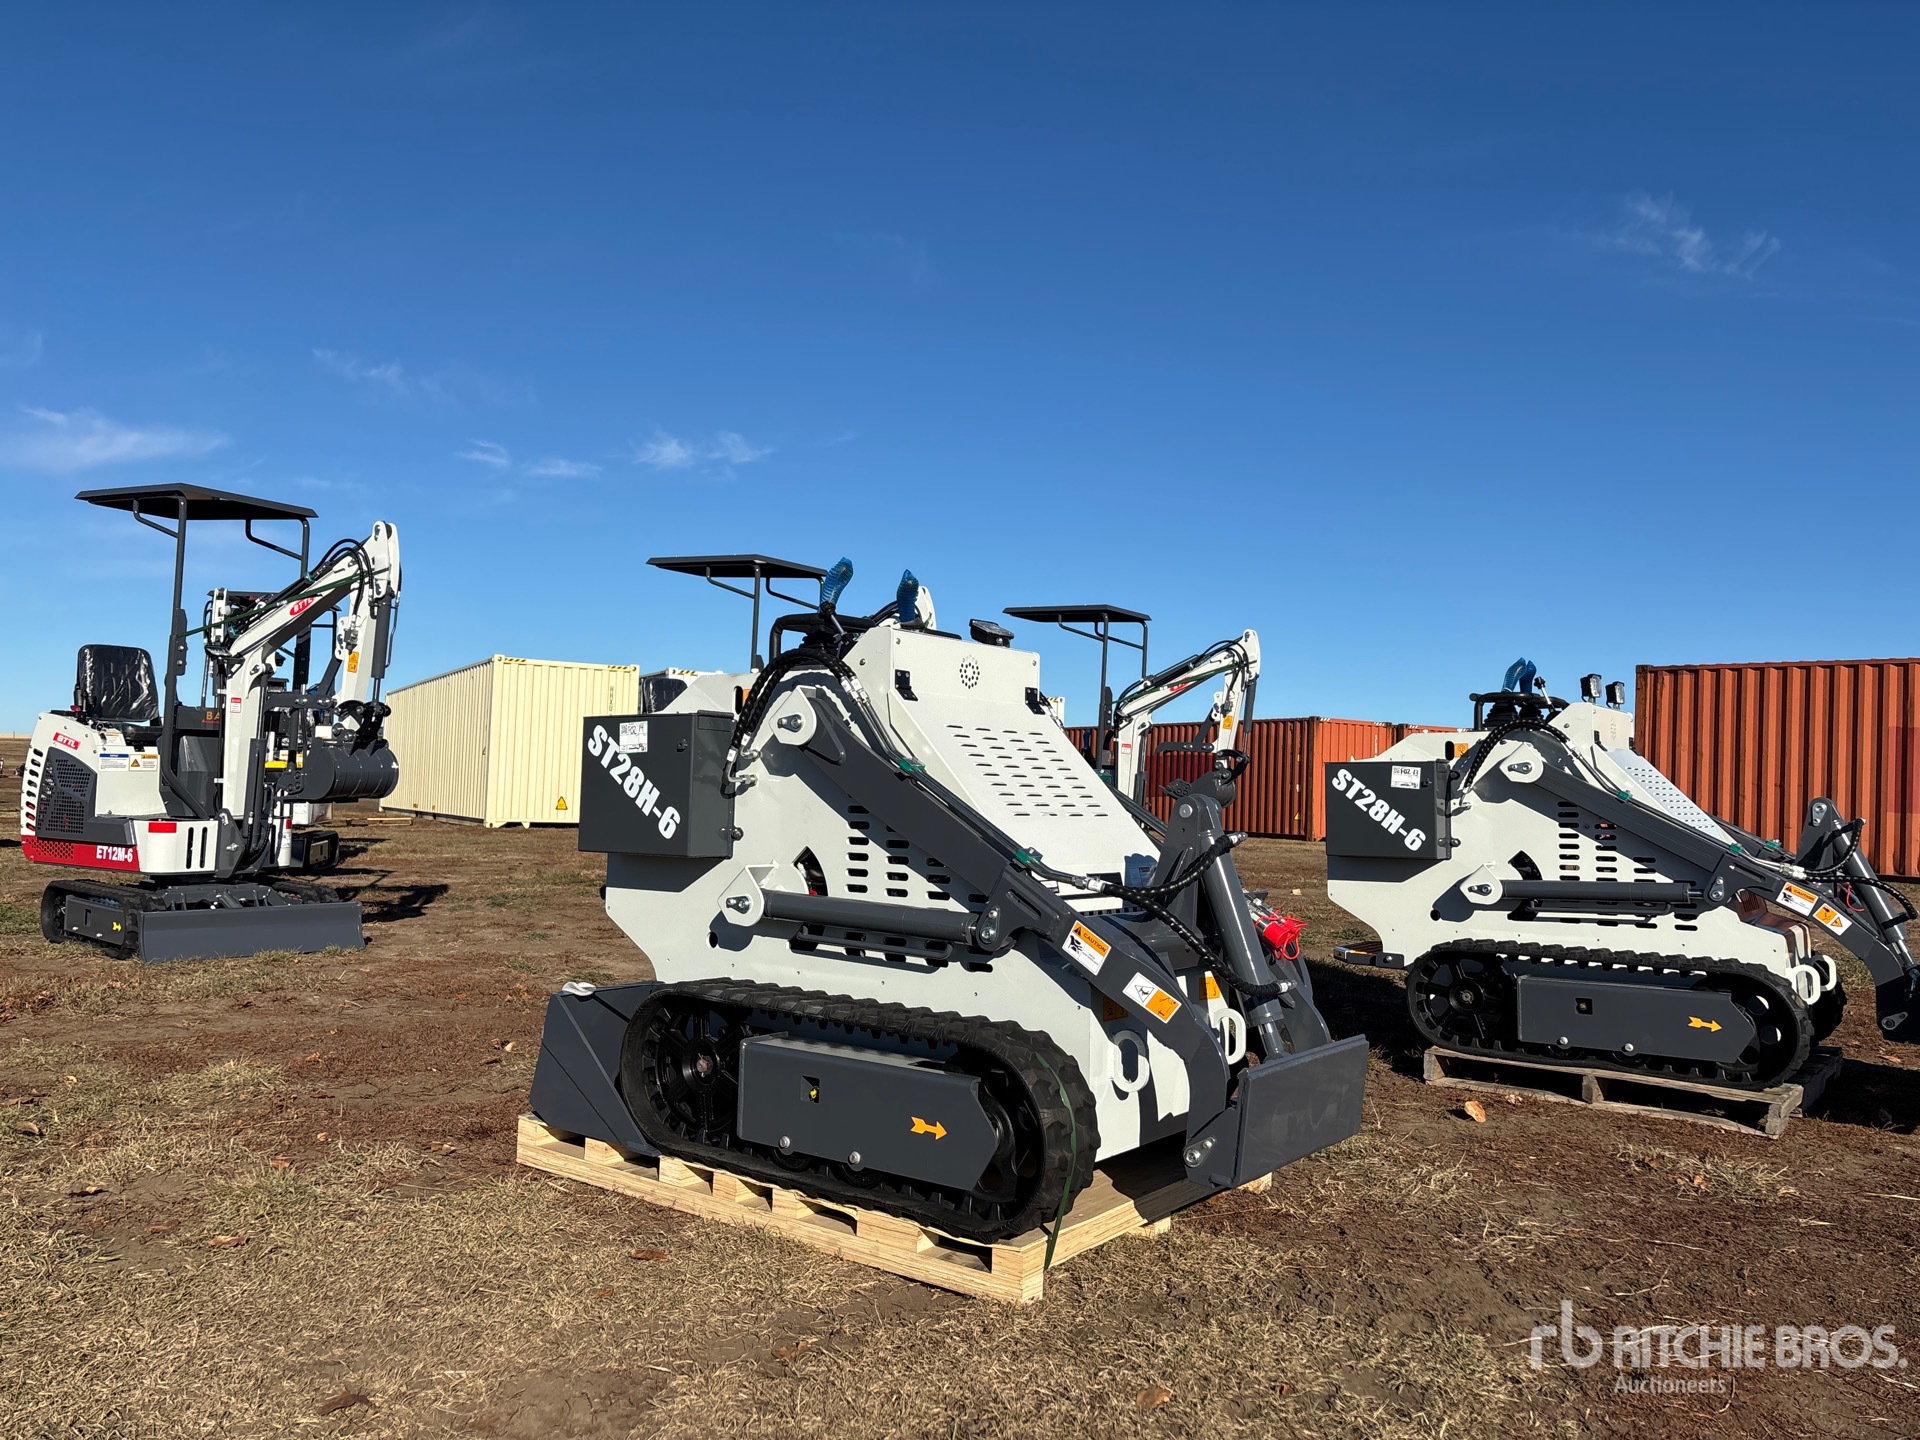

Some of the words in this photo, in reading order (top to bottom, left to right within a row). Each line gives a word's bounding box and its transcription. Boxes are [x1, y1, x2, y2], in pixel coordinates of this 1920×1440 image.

[57, 735, 76, 748] BTTL
[587, 724, 681, 840] ST28H-6
[1331, 768, 1427, 852] ST28H-6
[96, 845, 133, 862] ET12M-6
[1083, 932, 1107, 953] CAUTION
